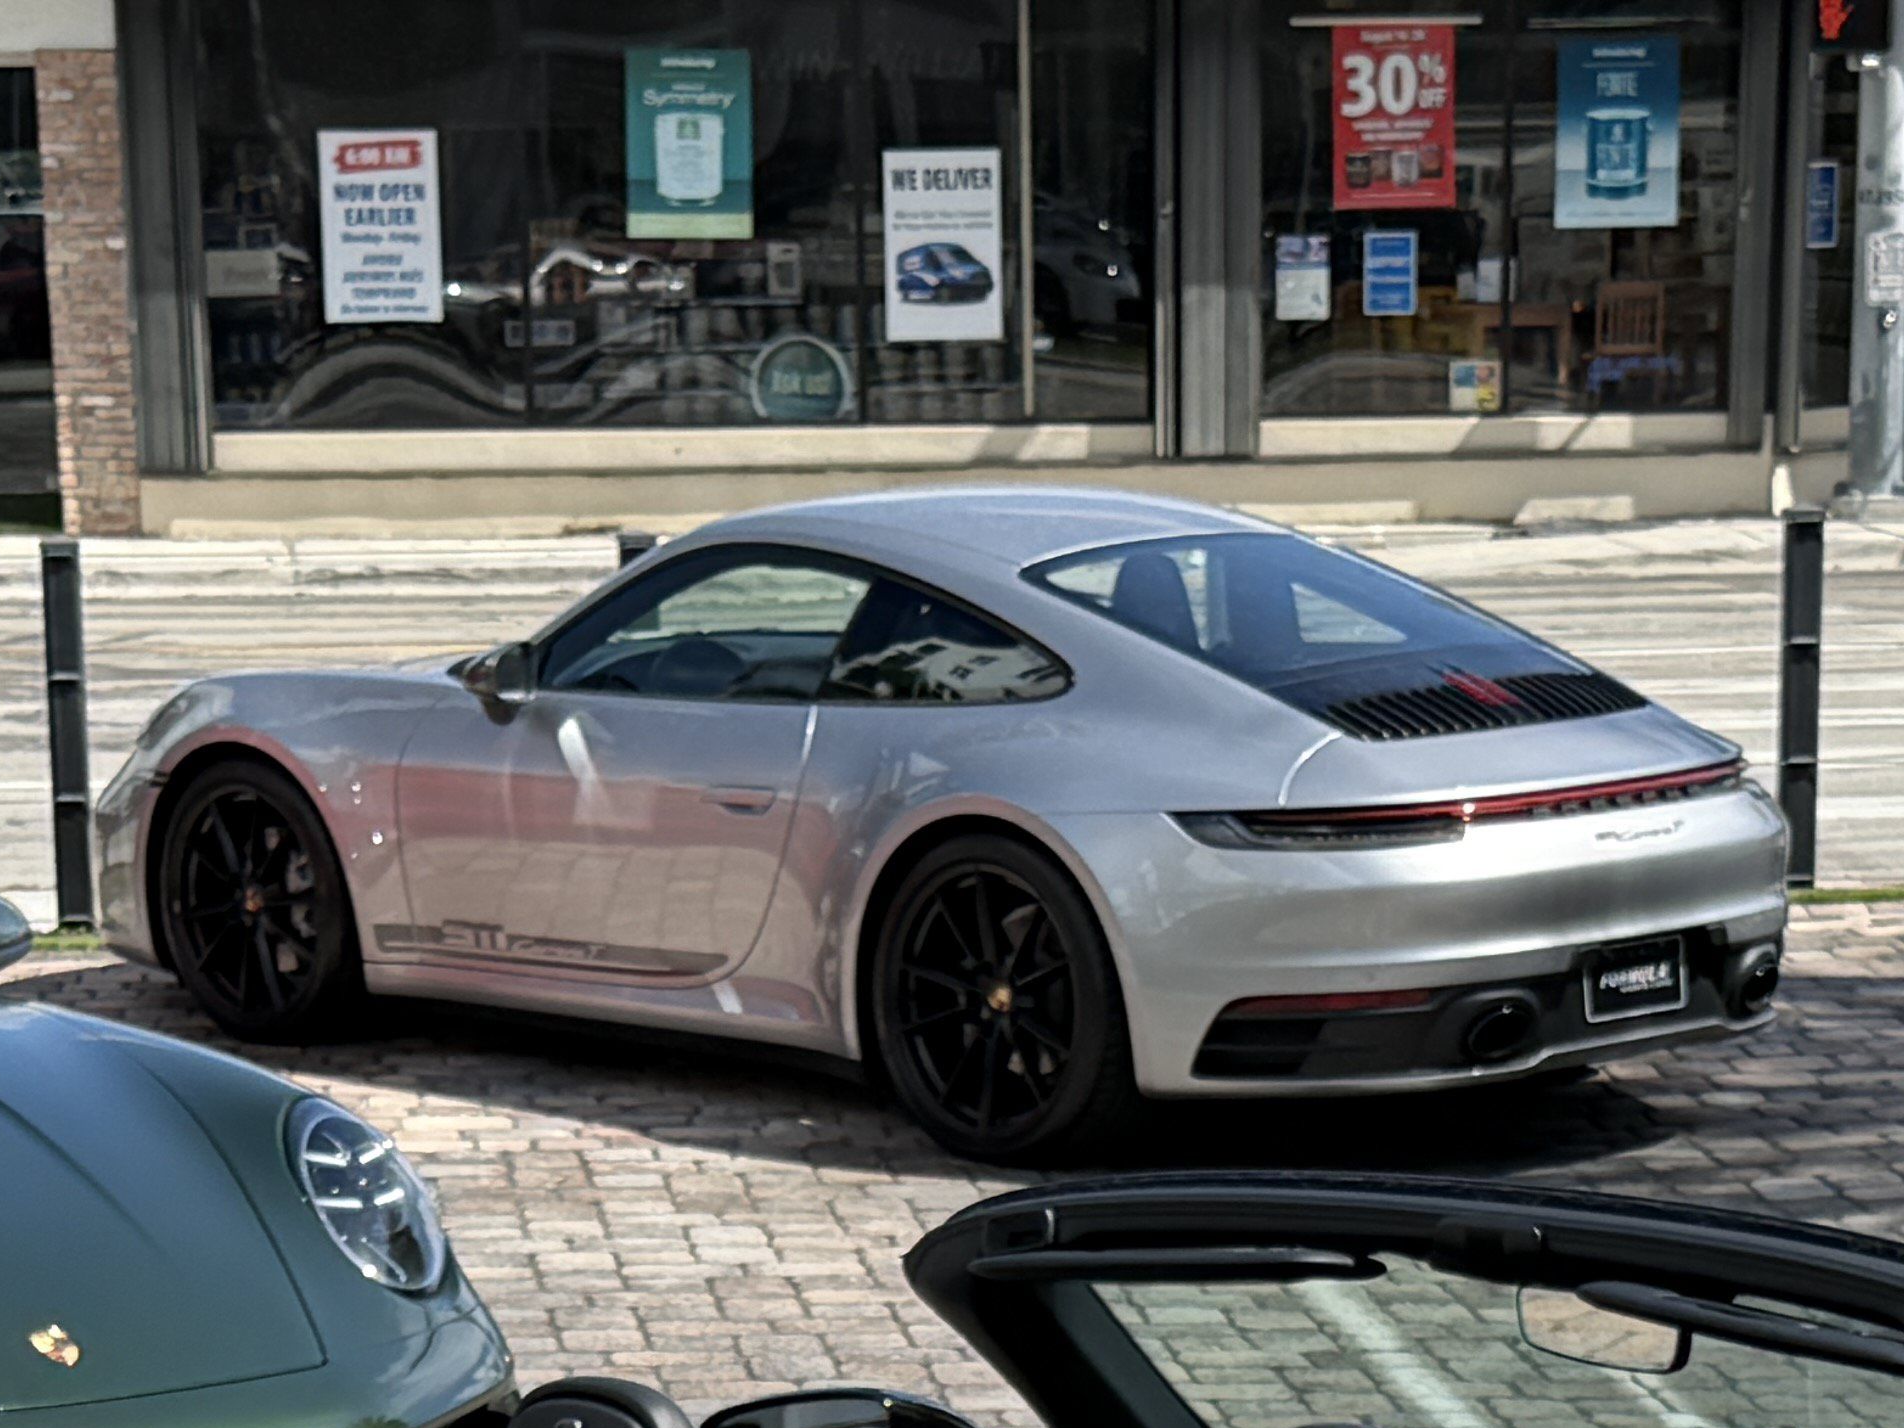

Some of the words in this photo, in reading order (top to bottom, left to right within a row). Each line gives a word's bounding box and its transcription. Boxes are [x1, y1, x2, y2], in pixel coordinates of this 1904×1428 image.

[643, 88, 736, 109] Symmetry
[1418, 88, 1446, 109] OFF
[893, 169, 917, 191] WE
[922, 167, 993, 191] DELIVER
[333, 183, 375, 202] NOW
[378, 183, 425, 202] OPEN
[343, 207, 416, 226] EARLIER
